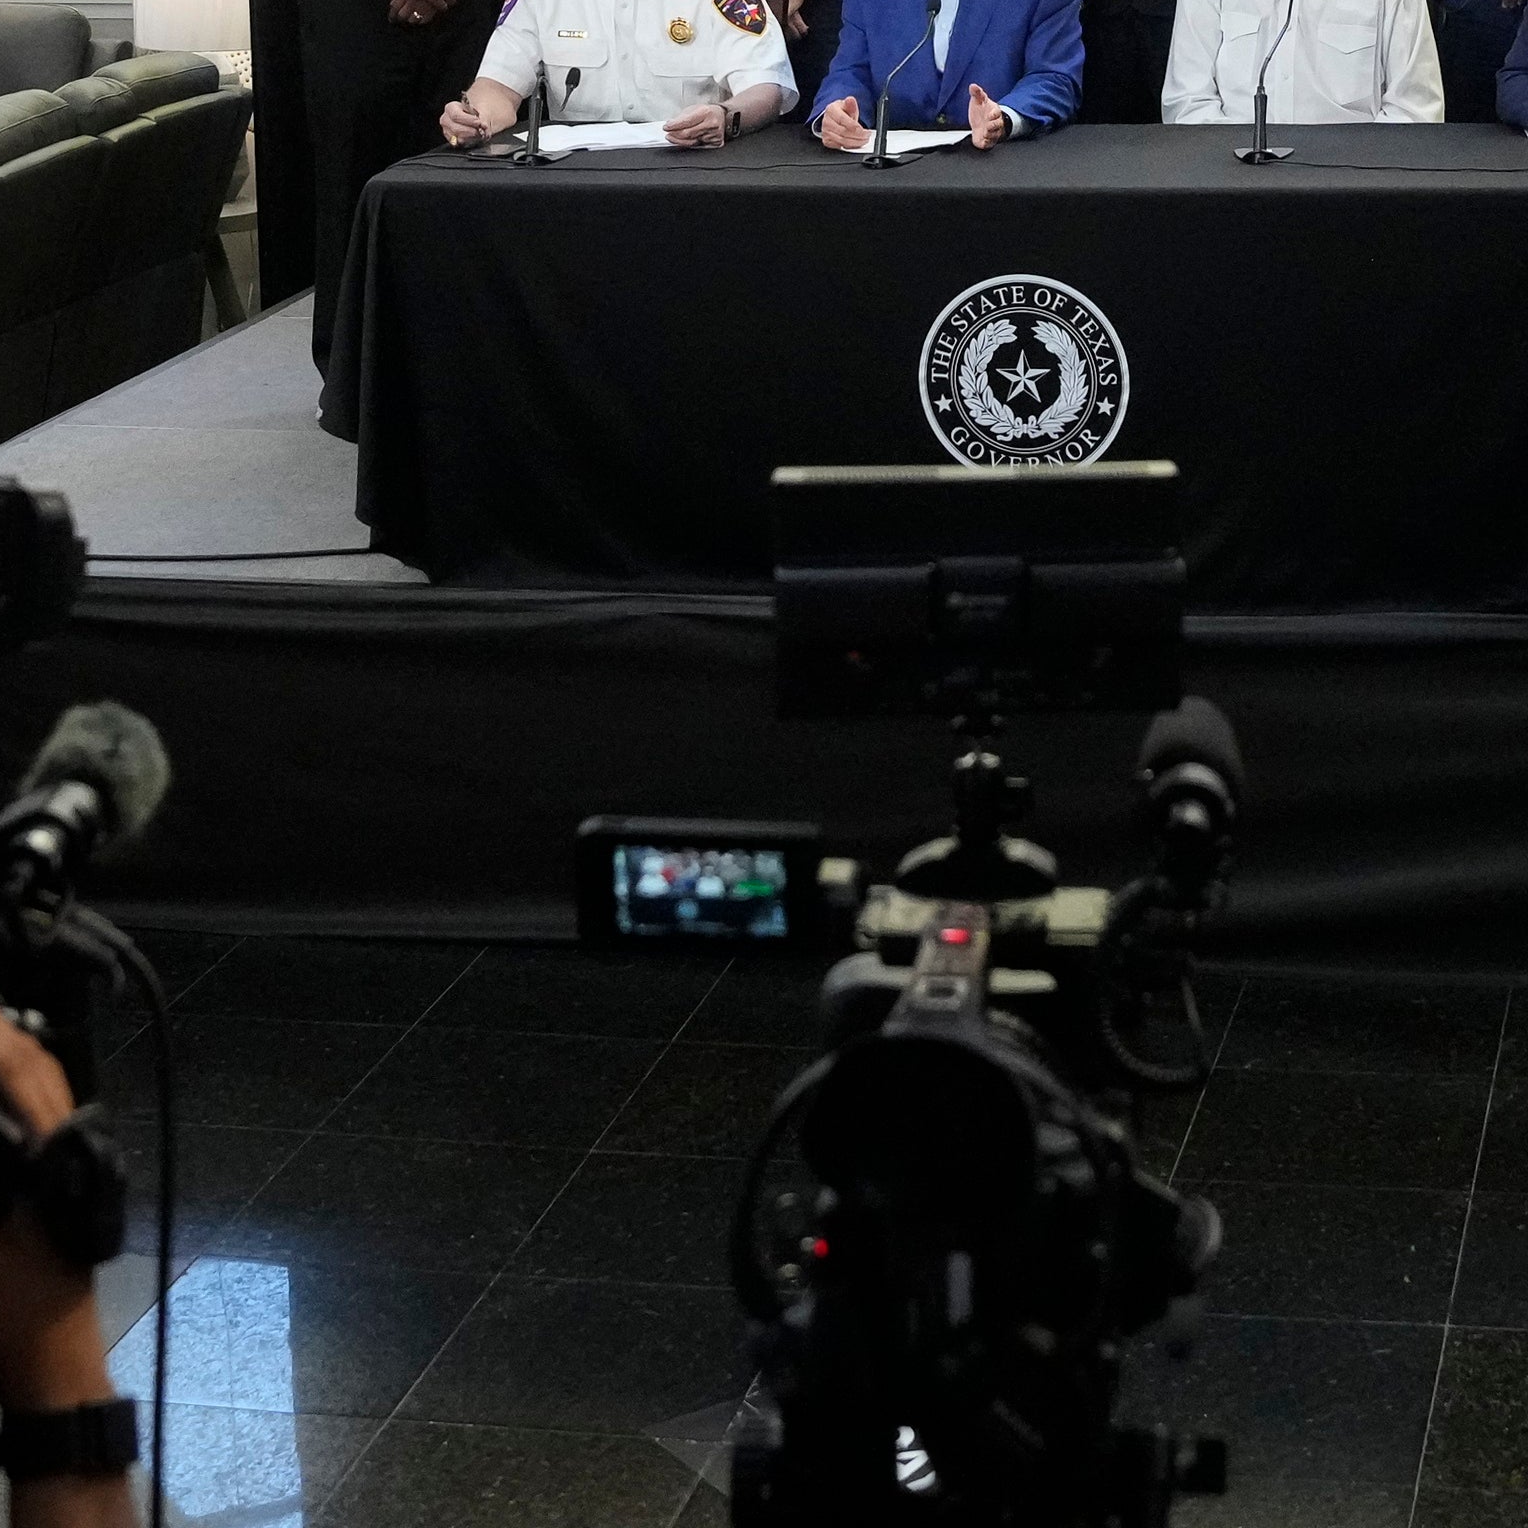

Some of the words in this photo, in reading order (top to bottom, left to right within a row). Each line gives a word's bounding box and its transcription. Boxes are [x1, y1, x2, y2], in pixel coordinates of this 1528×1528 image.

[931, 332, 957, 383] THE
[950, 286, 1026, 333] STATE
[1034, 288, 1068, 312] OF
[1070, 305, 1117, 386] TEXAS
